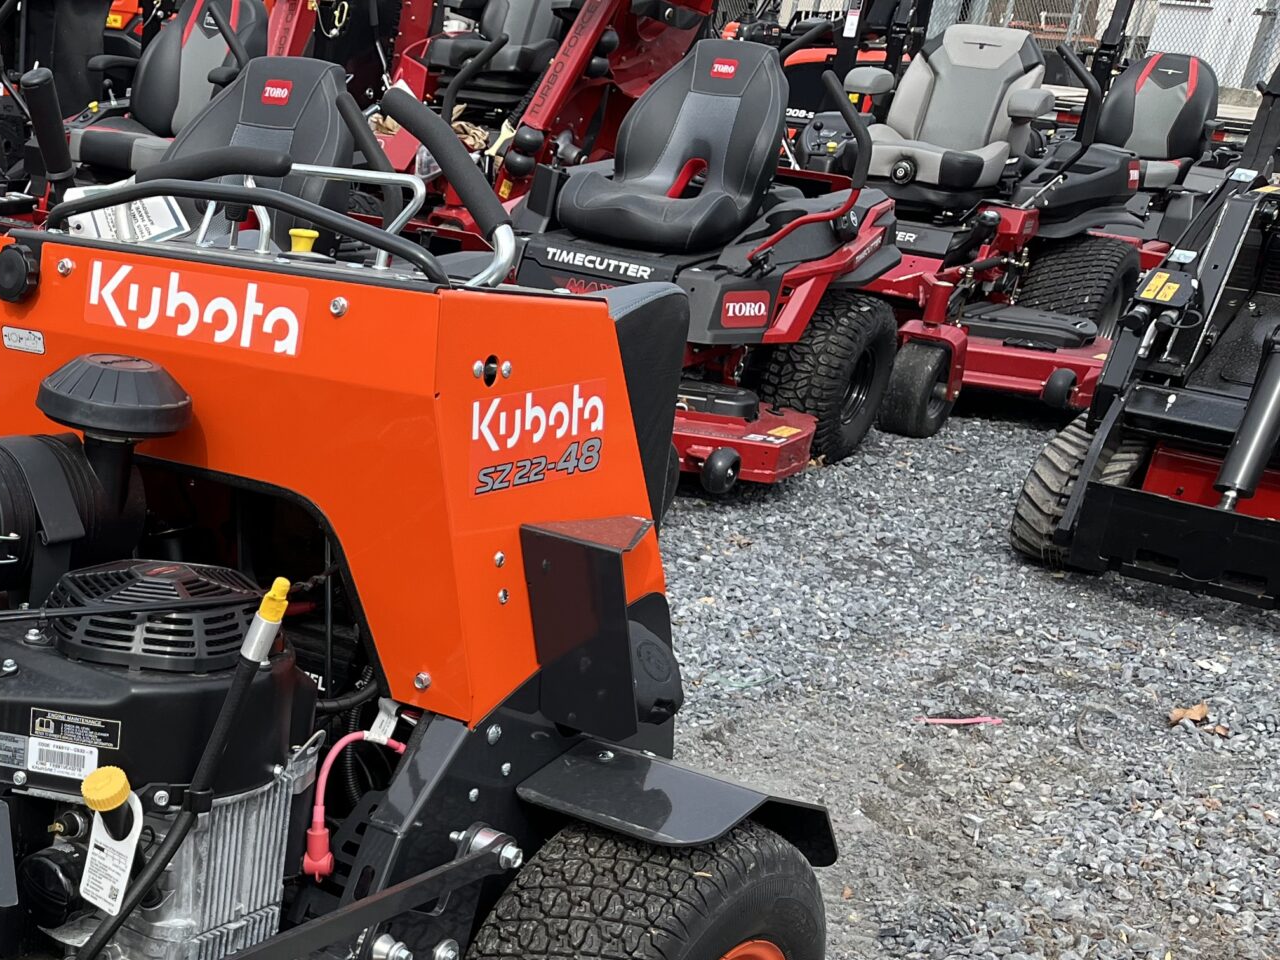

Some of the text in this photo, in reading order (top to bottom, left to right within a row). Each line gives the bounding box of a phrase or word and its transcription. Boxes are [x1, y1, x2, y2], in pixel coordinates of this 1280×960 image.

[530, 5, 598, 116] TURBO FORCE
[713, 64, 735, 73] TORO
[264, 86, 288, 98] TORO
[546, 247, 653, 280] TIMECUTTER
[89, 260, 299, 356] Kubota
[725, 301, 767, 317] TORO
[472, 384, 604, 452] Kubota
